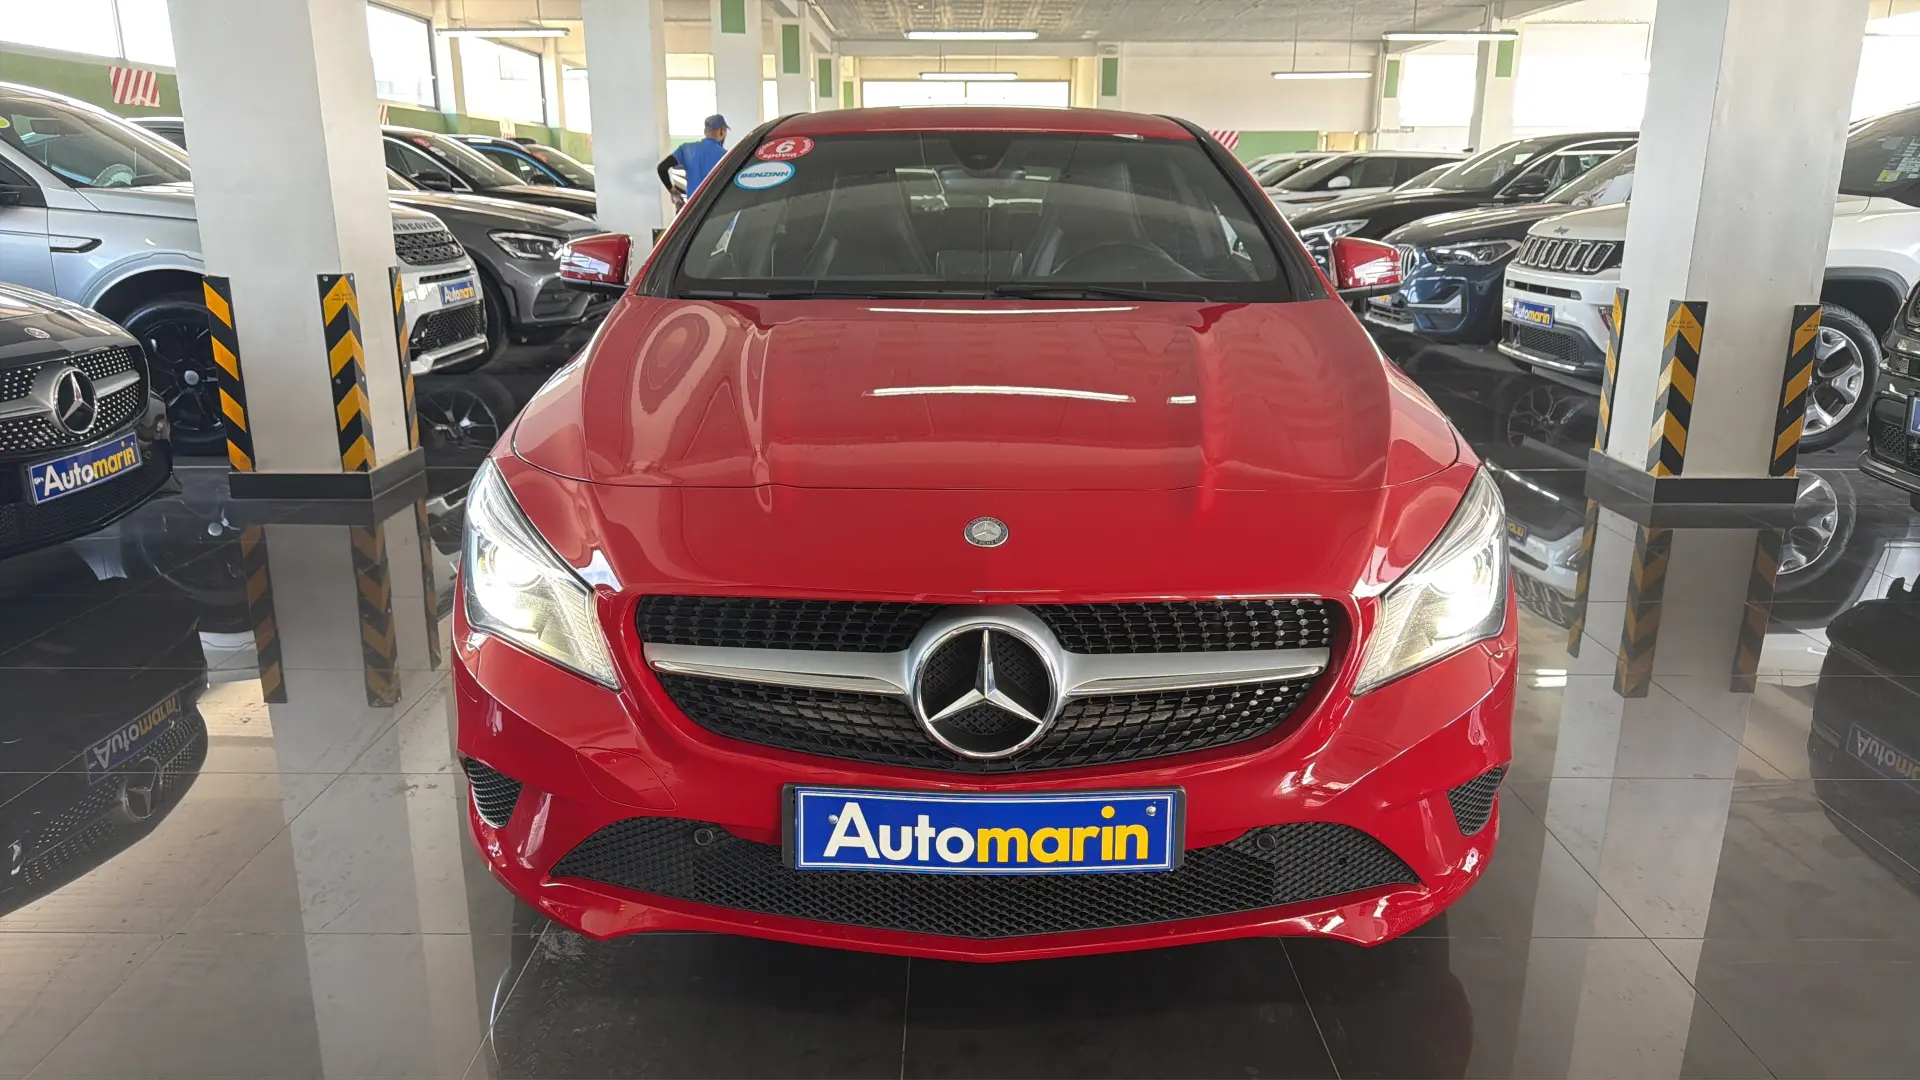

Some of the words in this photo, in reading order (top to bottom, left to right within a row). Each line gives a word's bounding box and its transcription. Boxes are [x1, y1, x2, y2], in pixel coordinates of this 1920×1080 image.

[775, 140, 796, 154] 6
[444, 281, 475, 304] Automarin
[1513, 301, 1550, 325] Automarin
[44, 440, 136, 497] Automarin
[822, 802, 1149, 863] Automarin
